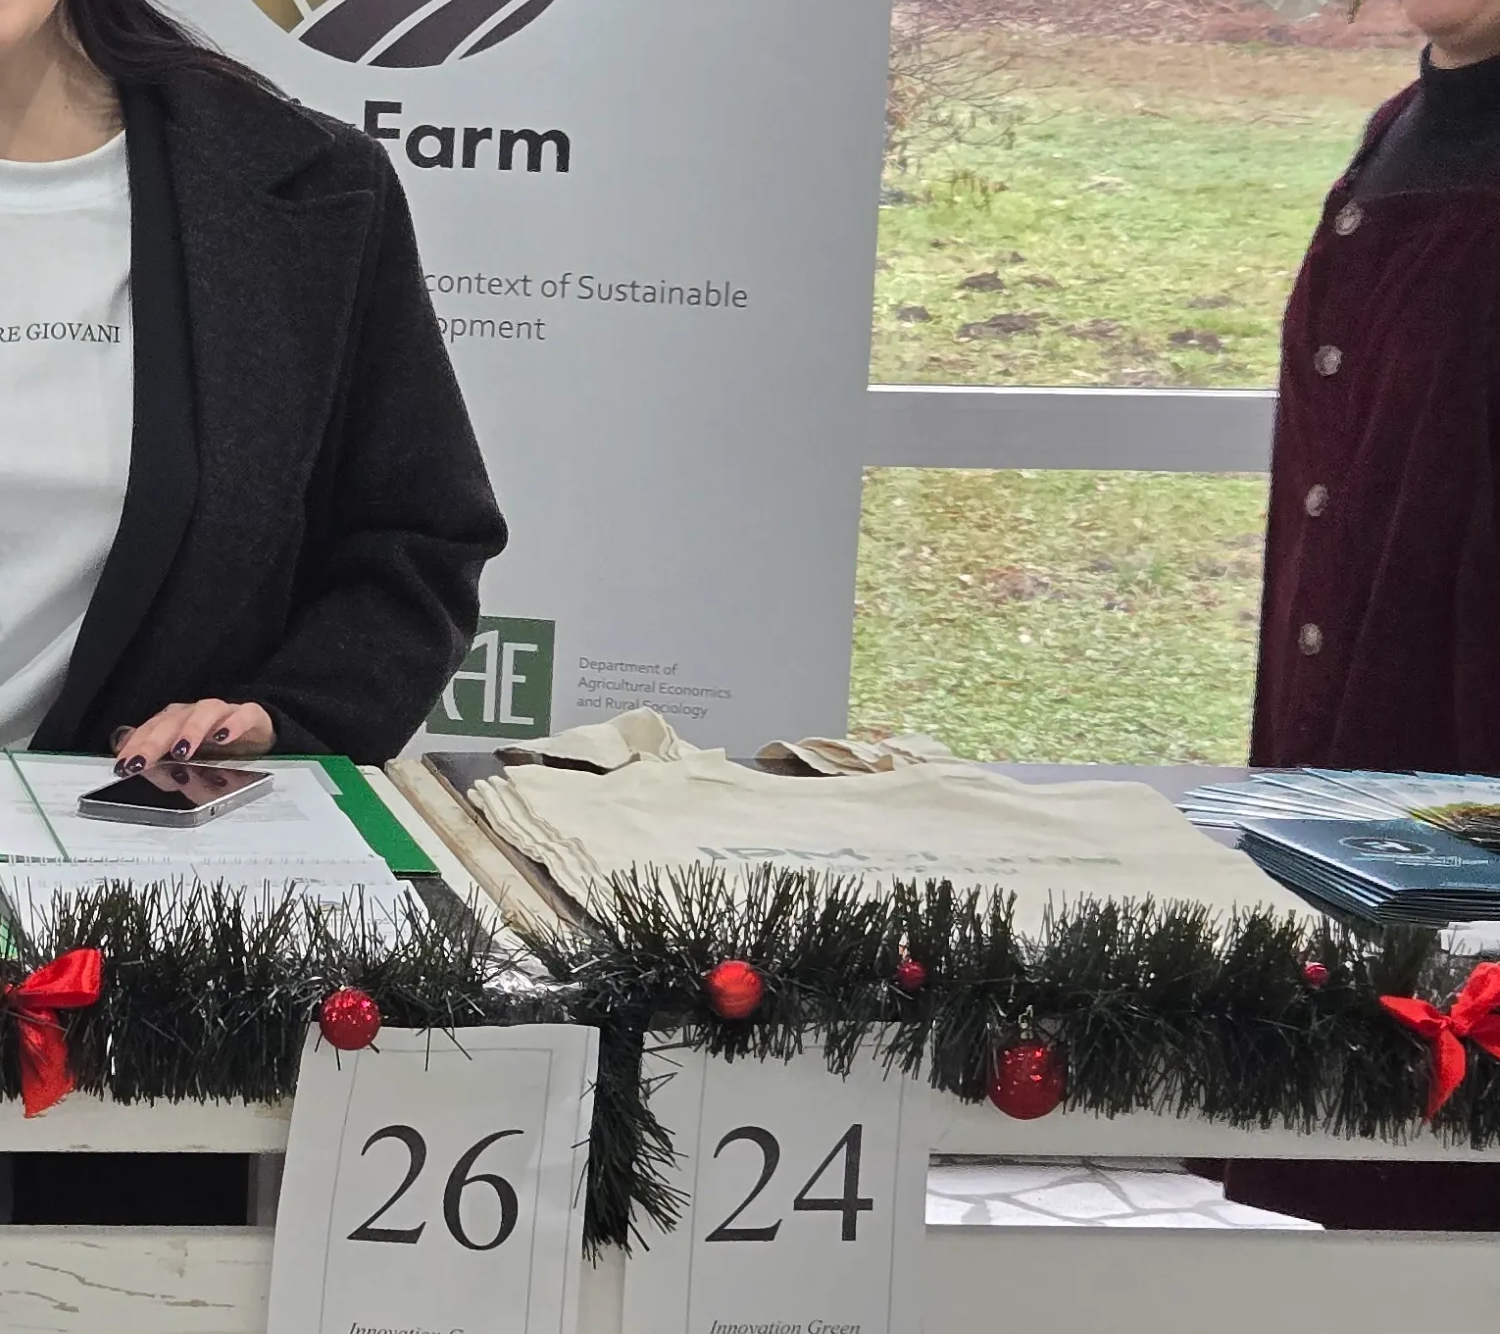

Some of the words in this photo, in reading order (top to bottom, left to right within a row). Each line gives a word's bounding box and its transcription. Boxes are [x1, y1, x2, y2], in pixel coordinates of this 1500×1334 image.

[363, 99, 571, 174] Farm
[425, 271, 533, 299] context
[540, 271, 574, 300] of
[577, 275, 749, 309] Sustainable
[25, 321, 121, 344] GIOVANI
[579, 656, 660, 676] Department
[662, 662, 679, 676] of
[577, 676, 656, 695] Agricultural
[659, 682, 732, 700] Economics
[576, 695, 601, 710] and
[605, 697, 640, 713] Rural
[642, 699, 708, 719] Sociology
[346, 1124, 525, 1251] 26
[705, 1123, 874, 1242] 24
